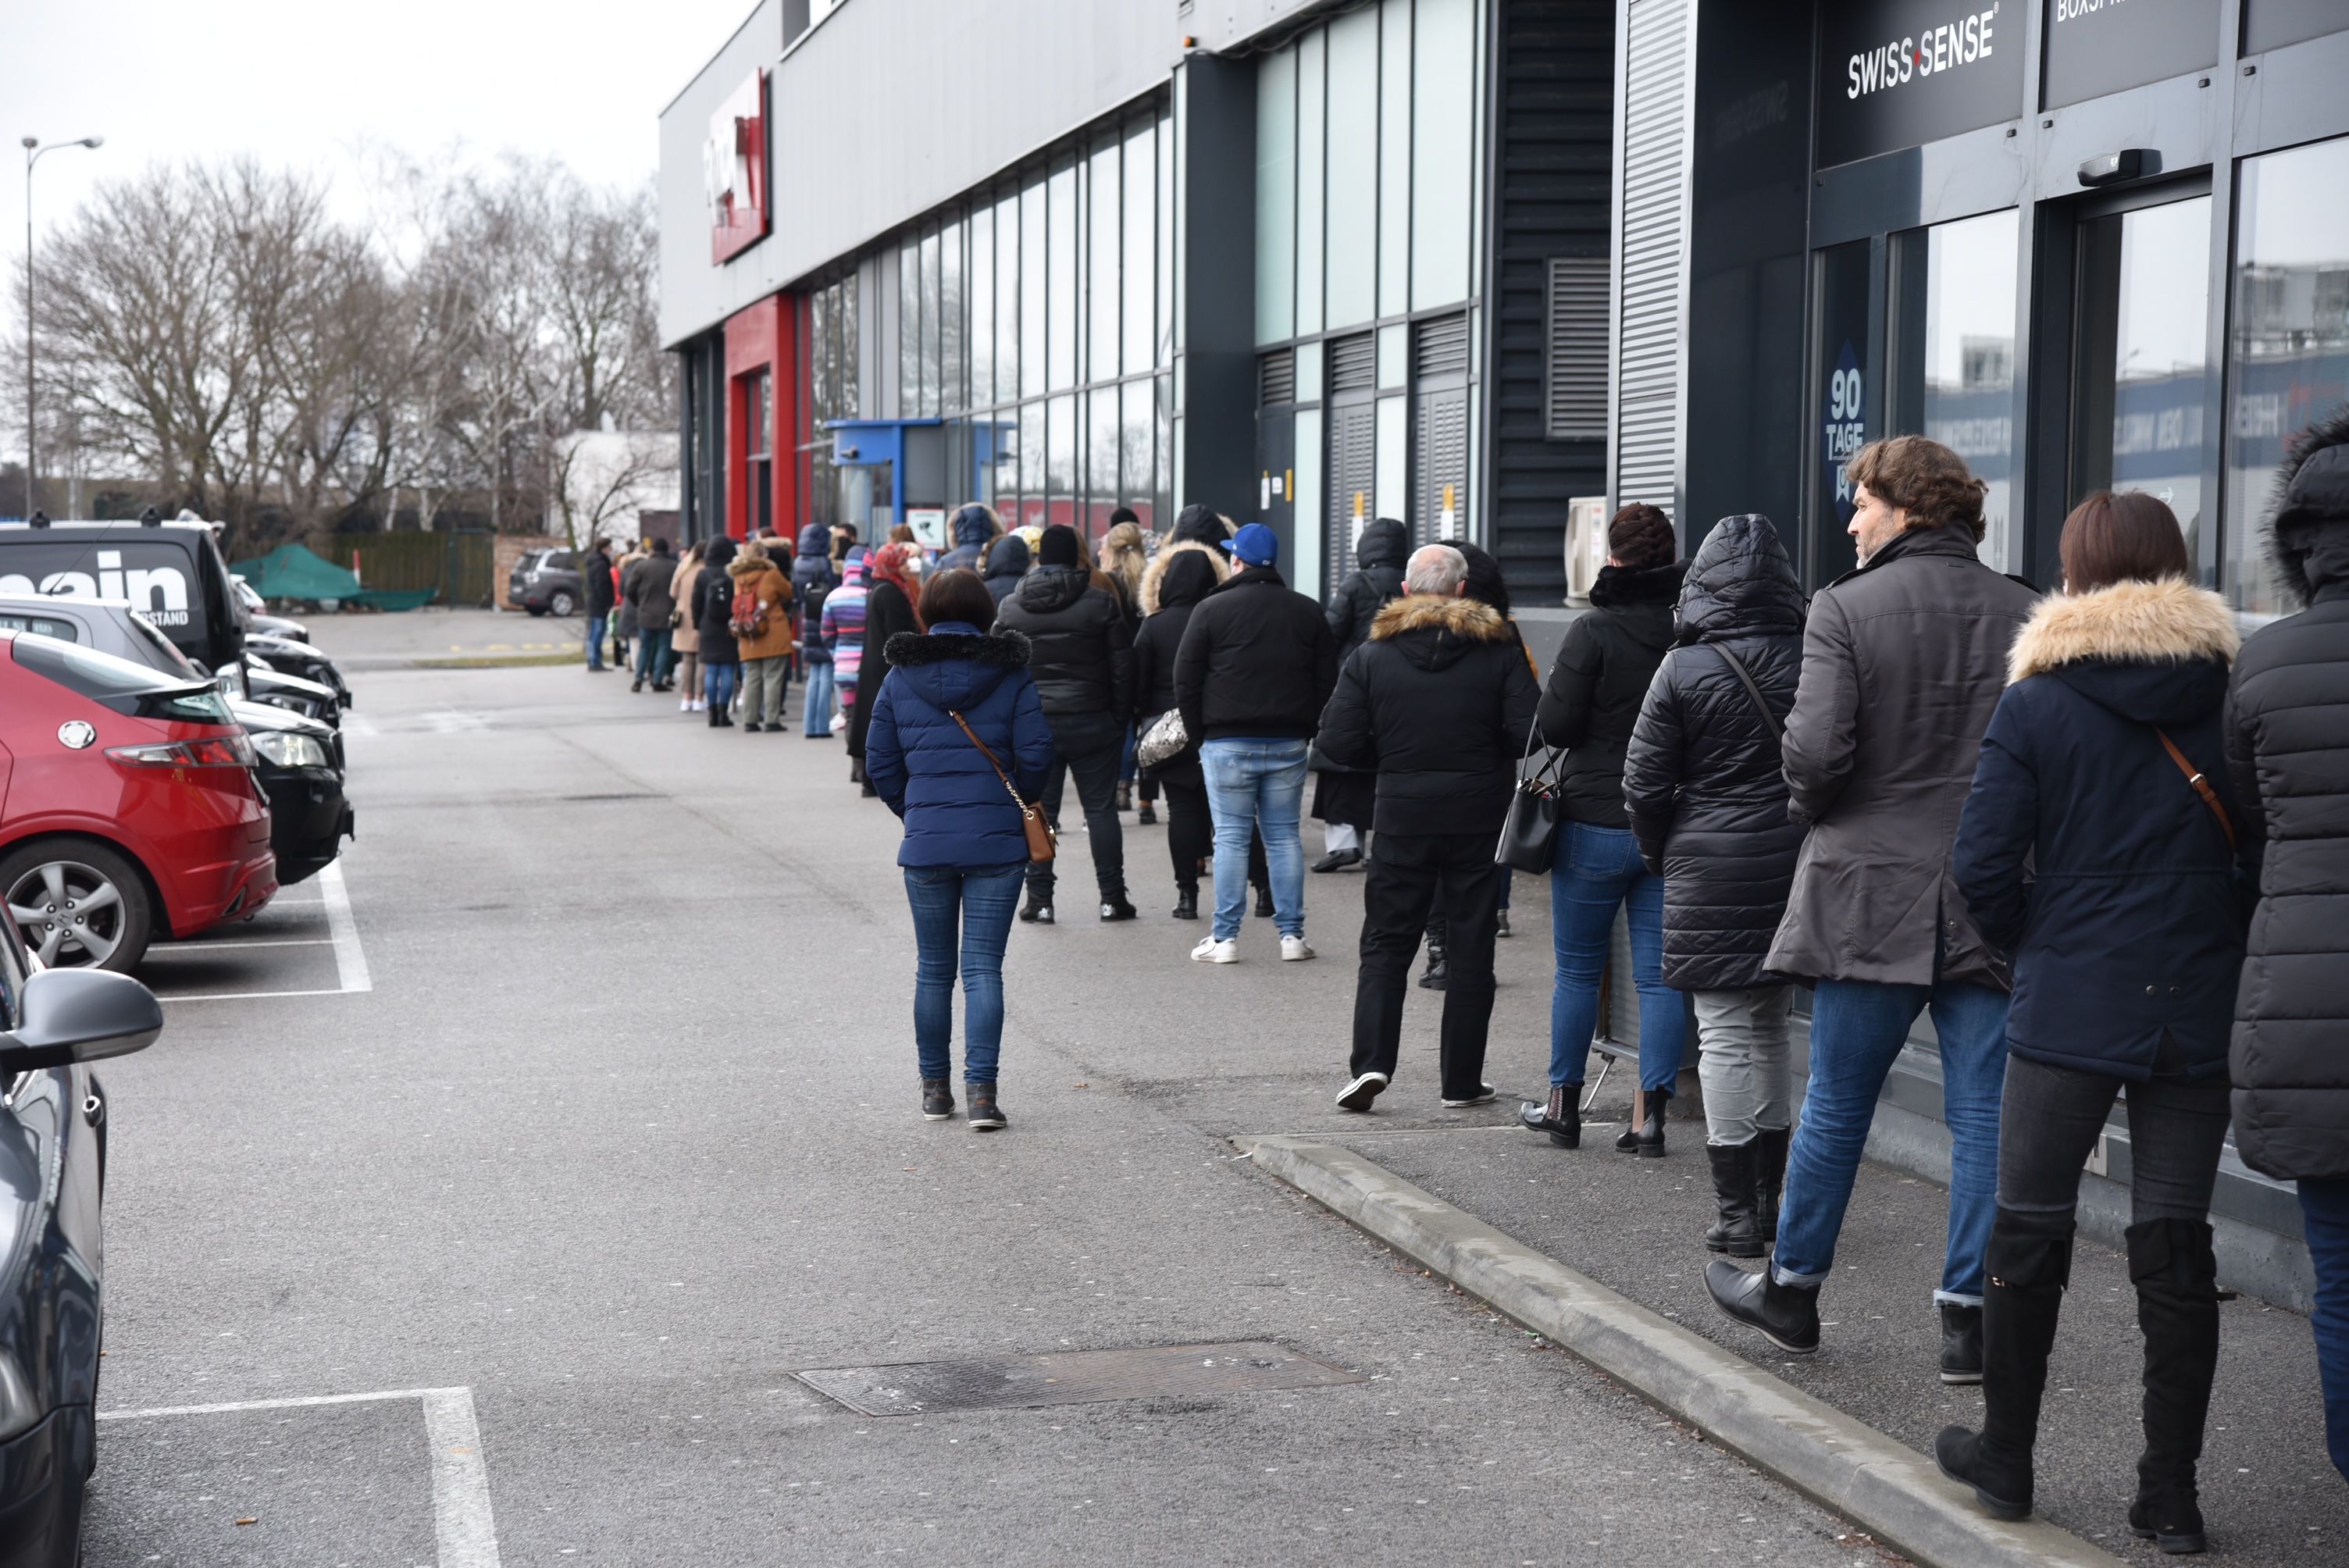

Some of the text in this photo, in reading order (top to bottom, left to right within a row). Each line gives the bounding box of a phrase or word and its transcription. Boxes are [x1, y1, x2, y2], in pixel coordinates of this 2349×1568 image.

[1848, 37, 1913, 99] SWISS
[1831, 368, 1861, 420] 90
[0, 551, 188, 611] ain
